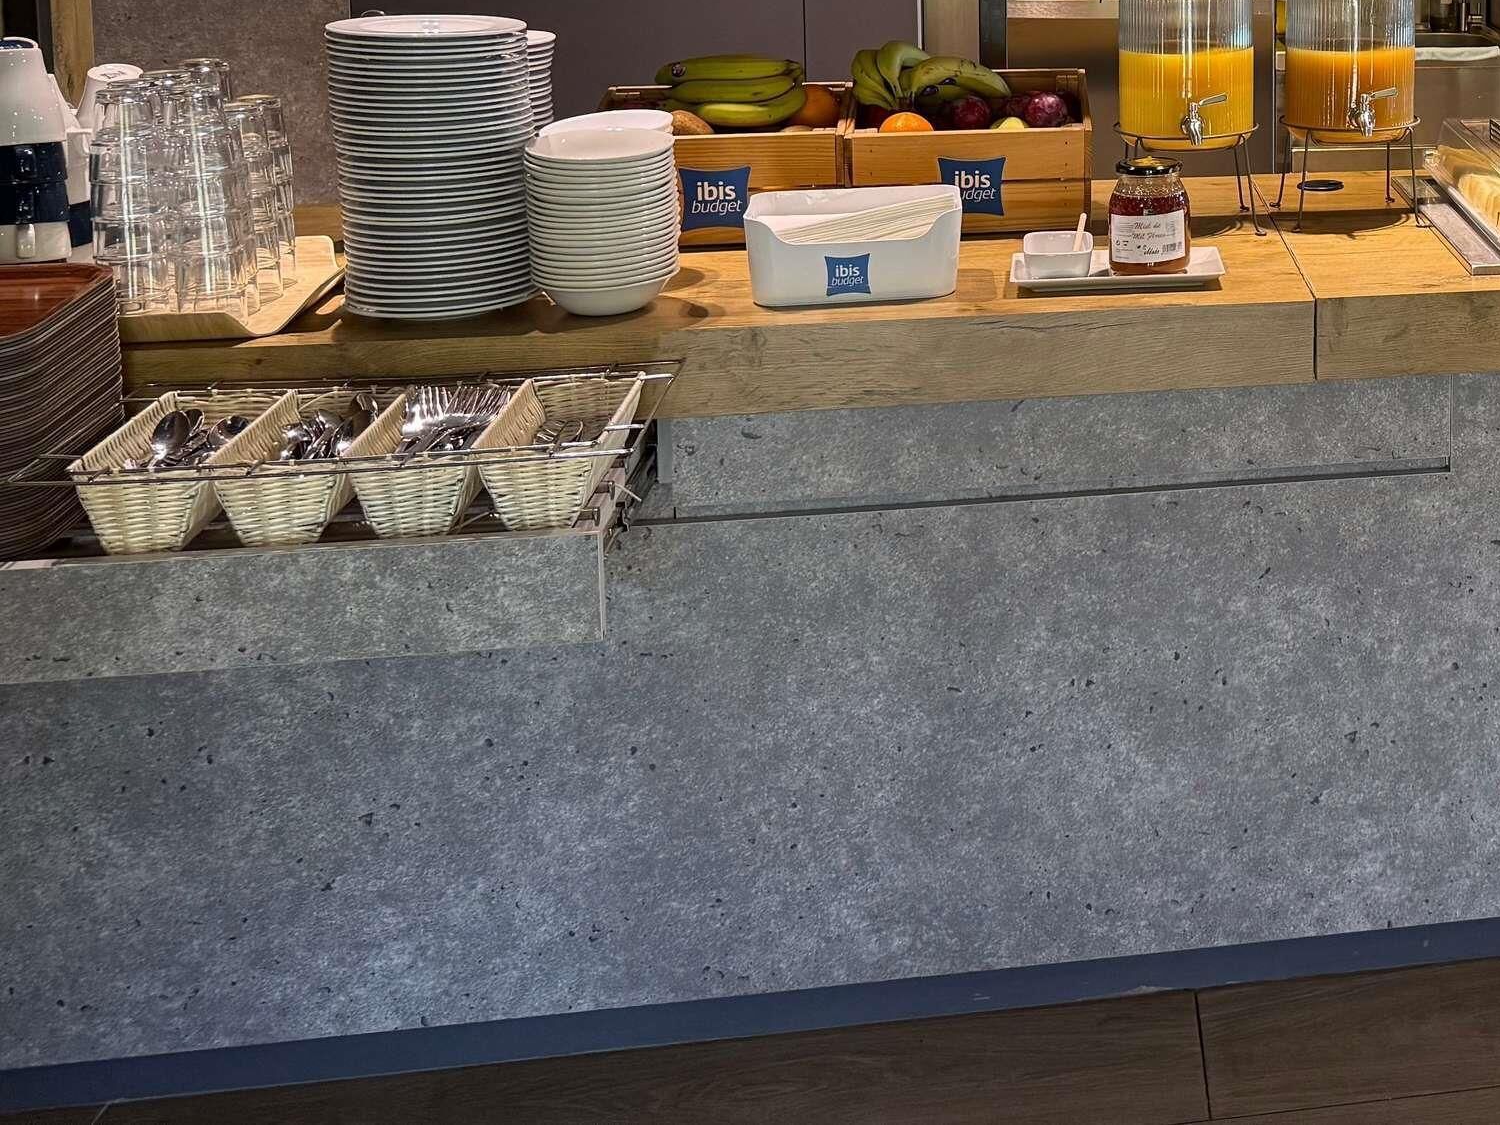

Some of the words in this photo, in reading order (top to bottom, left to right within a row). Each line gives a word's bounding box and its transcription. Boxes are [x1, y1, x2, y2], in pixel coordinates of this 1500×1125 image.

[954, 170, 991, 189] ibis
[696, 181, 736, 201] ibis
[961, 187, 997, 203] dget
[691, 197, 743, 216] budget
[835, 264, 860, 277] ibis
[831, 274, 864, 288] budget
